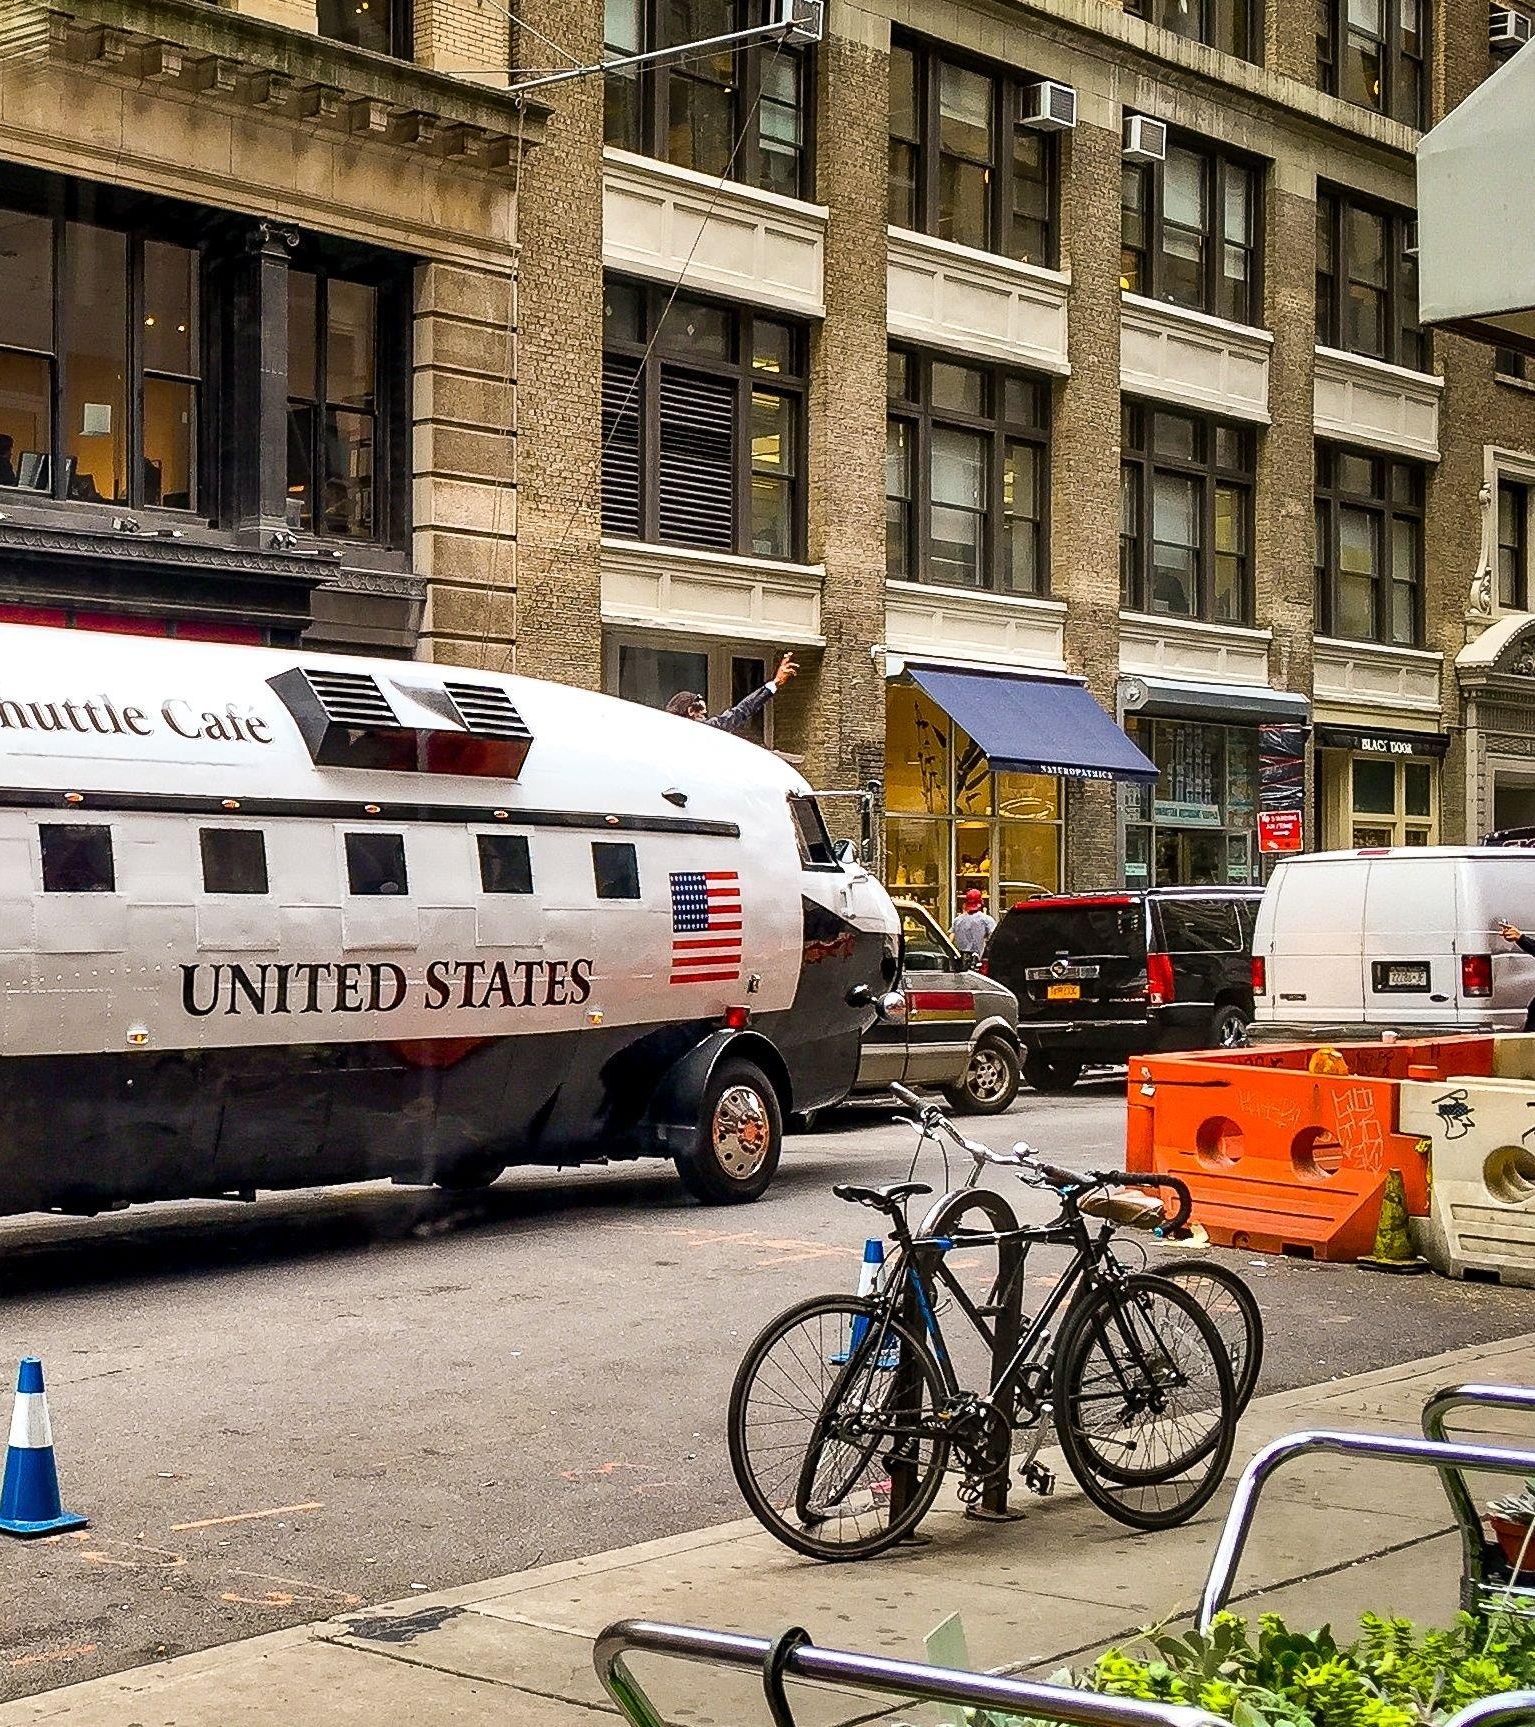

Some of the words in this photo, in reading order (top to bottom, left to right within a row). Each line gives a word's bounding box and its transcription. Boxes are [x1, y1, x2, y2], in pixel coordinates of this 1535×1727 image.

[160, 698, 275, 744] Café
[1389, 741, 1413, 754] DOOR
[178, 961, 408, 1017] UNITED
[424, 957, 595, 1011] STATES
